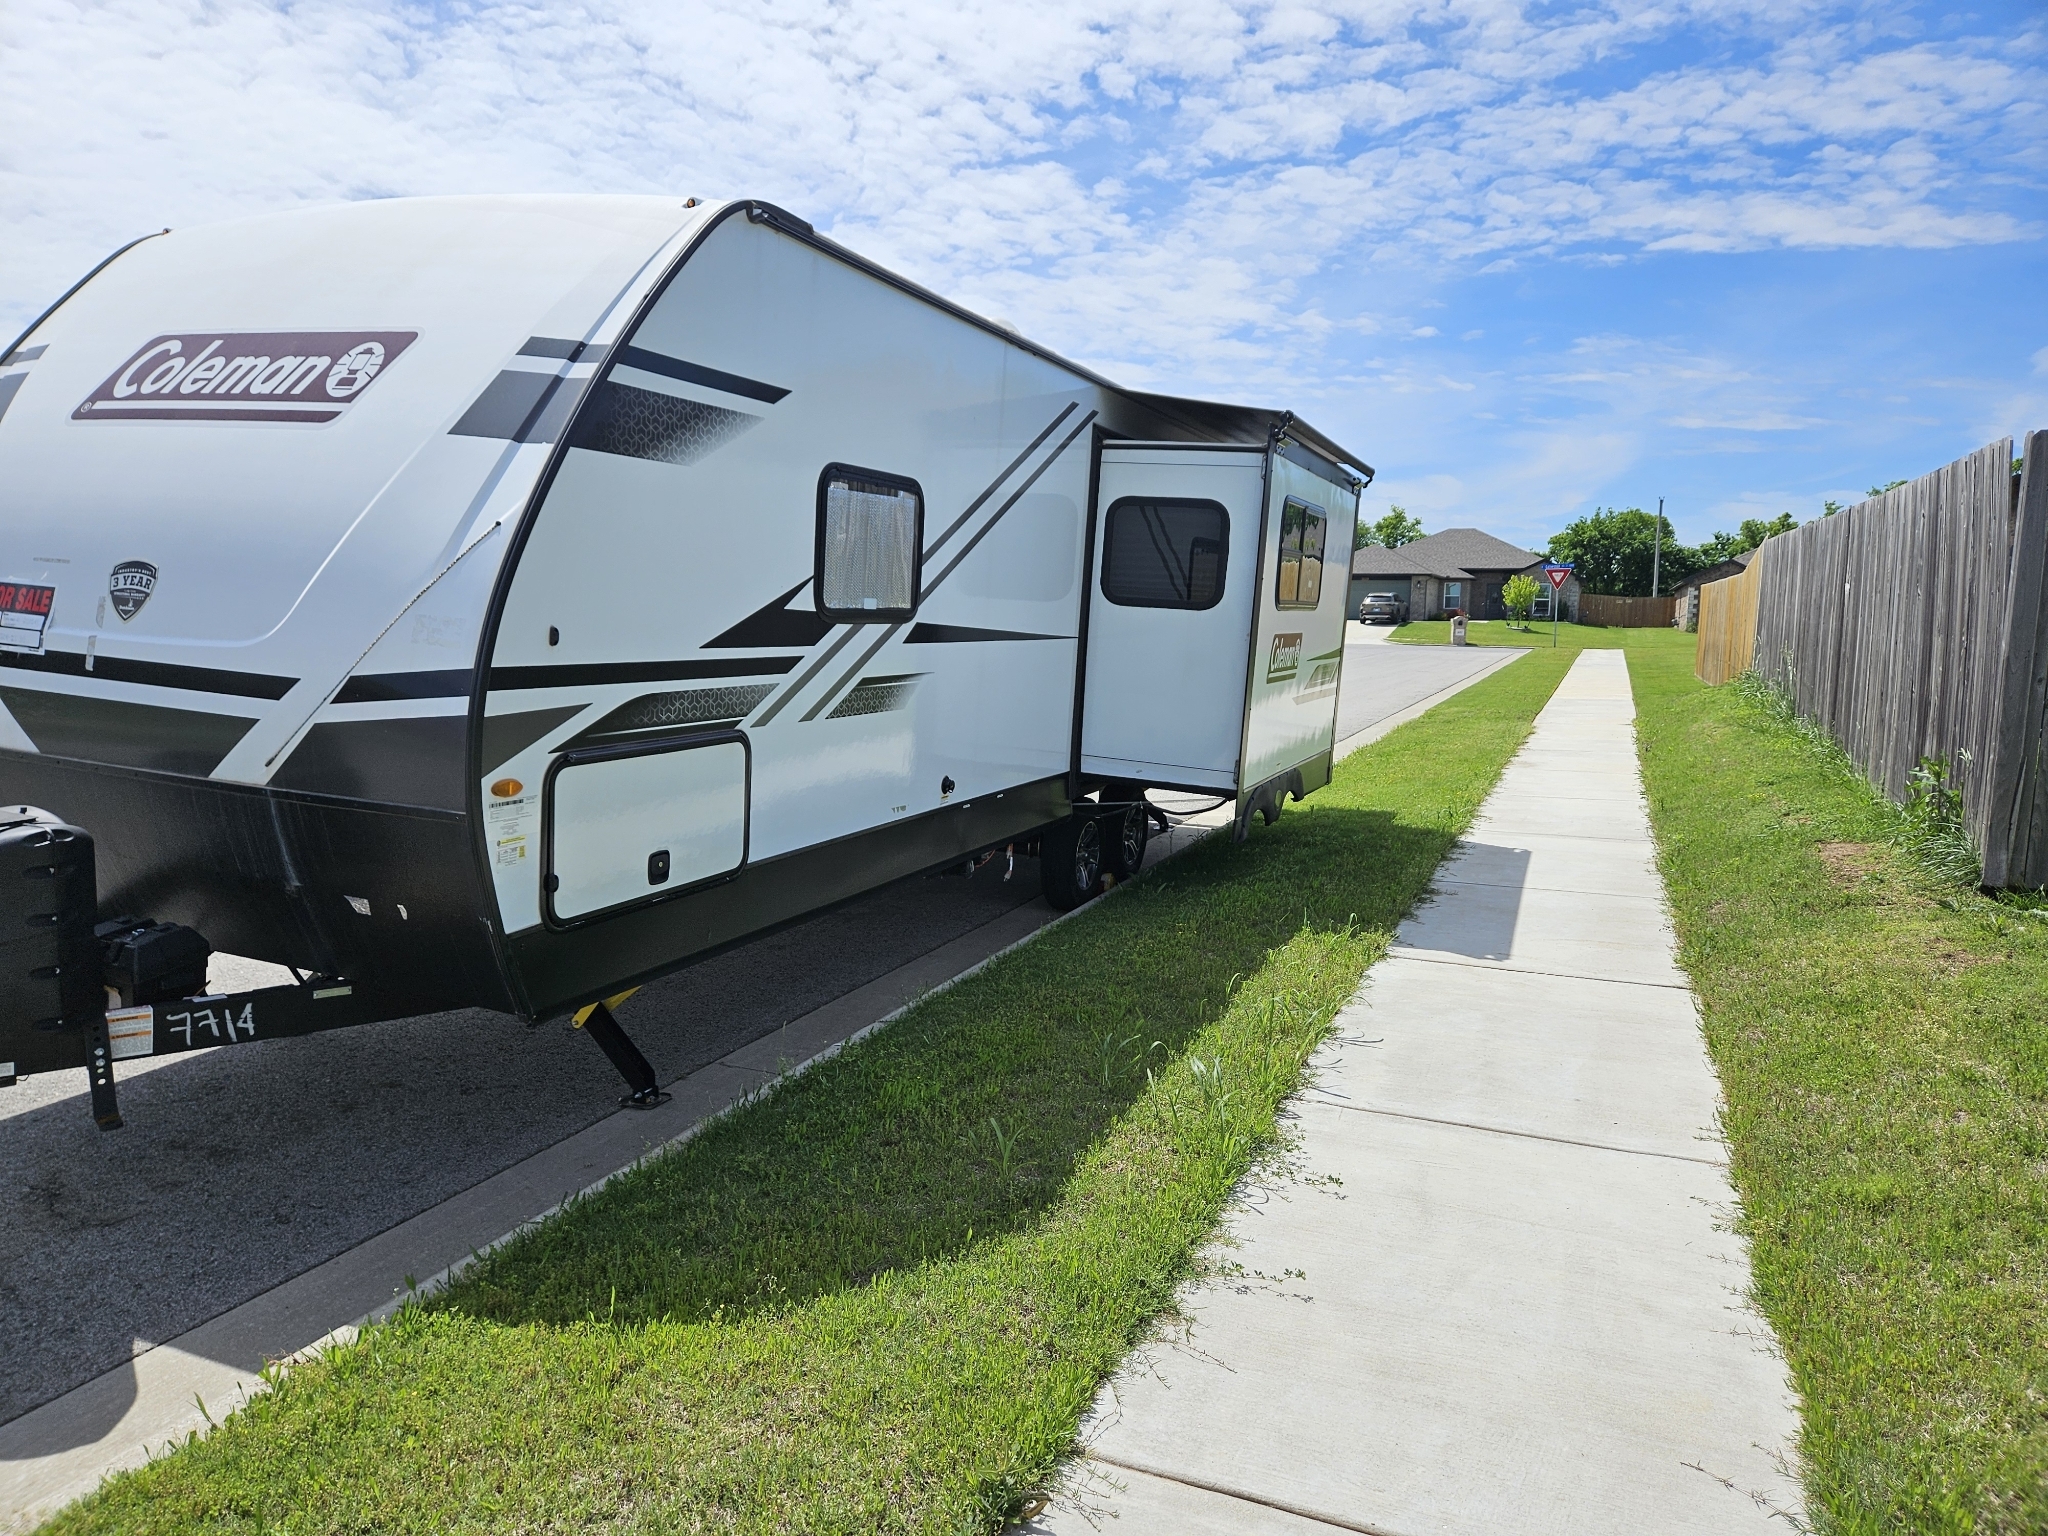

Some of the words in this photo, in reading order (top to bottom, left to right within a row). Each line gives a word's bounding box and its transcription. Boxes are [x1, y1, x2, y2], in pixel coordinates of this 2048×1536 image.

[113, 339, 332, 398] Coleman
[112, 576, 119, 588] 3
[123, 575, 152, 590] YEAR
[15, 587, 52, 613] SALE
[166, 1003, 255, 1046] 7714
